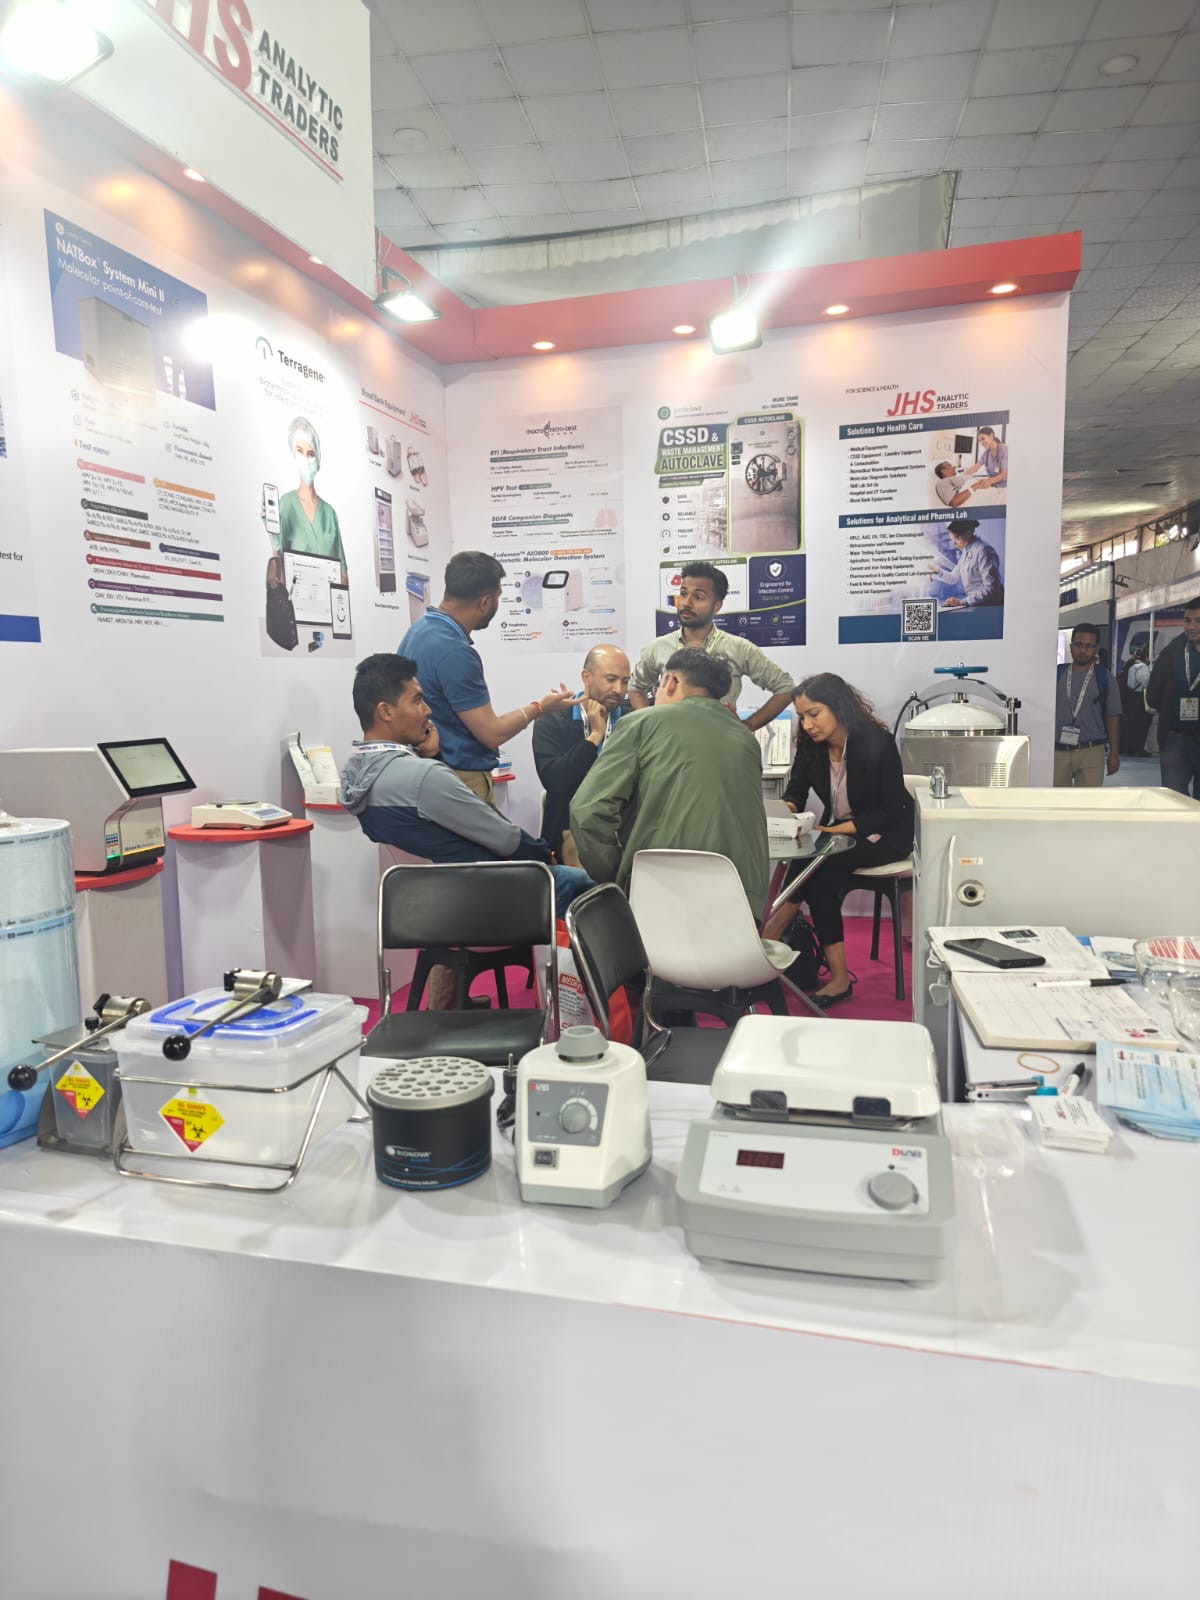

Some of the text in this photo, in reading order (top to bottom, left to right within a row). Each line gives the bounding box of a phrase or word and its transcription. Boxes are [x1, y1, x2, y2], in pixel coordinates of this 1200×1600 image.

[258, 29, 343, 131] ANALYTIC
[258, 65, 339, 162] TRADERS
[56, 237, 98, 269] NATBox
[102, 260, 136, 288] System
[138, 278, 157, 298] Mini
[58, 258, 100, 286] Molecular
[278, 350, 324, 383] Terragene
[887, 390, 936, 416] JHS
[936, 393, 969, 402] ANALYTIC
[937, 401, 968, 410] TRADERS
[663, 427, 718, 446] CSSD &
[847, 426, 875, 436] Solutions
[887, 424, 907, 432] Health
[908, 422, 924, 430] Care
[662, 444, 724, 456] WASTE MANAGEMENT
[662, 454, 723, 470] AUTOCLAVE
[846, 517, 874, 526] Solutions
[886, 514, 916, 524] Analytical
[930, 512, 954, 520] Pharma
[14, 552, 24, 560] for
